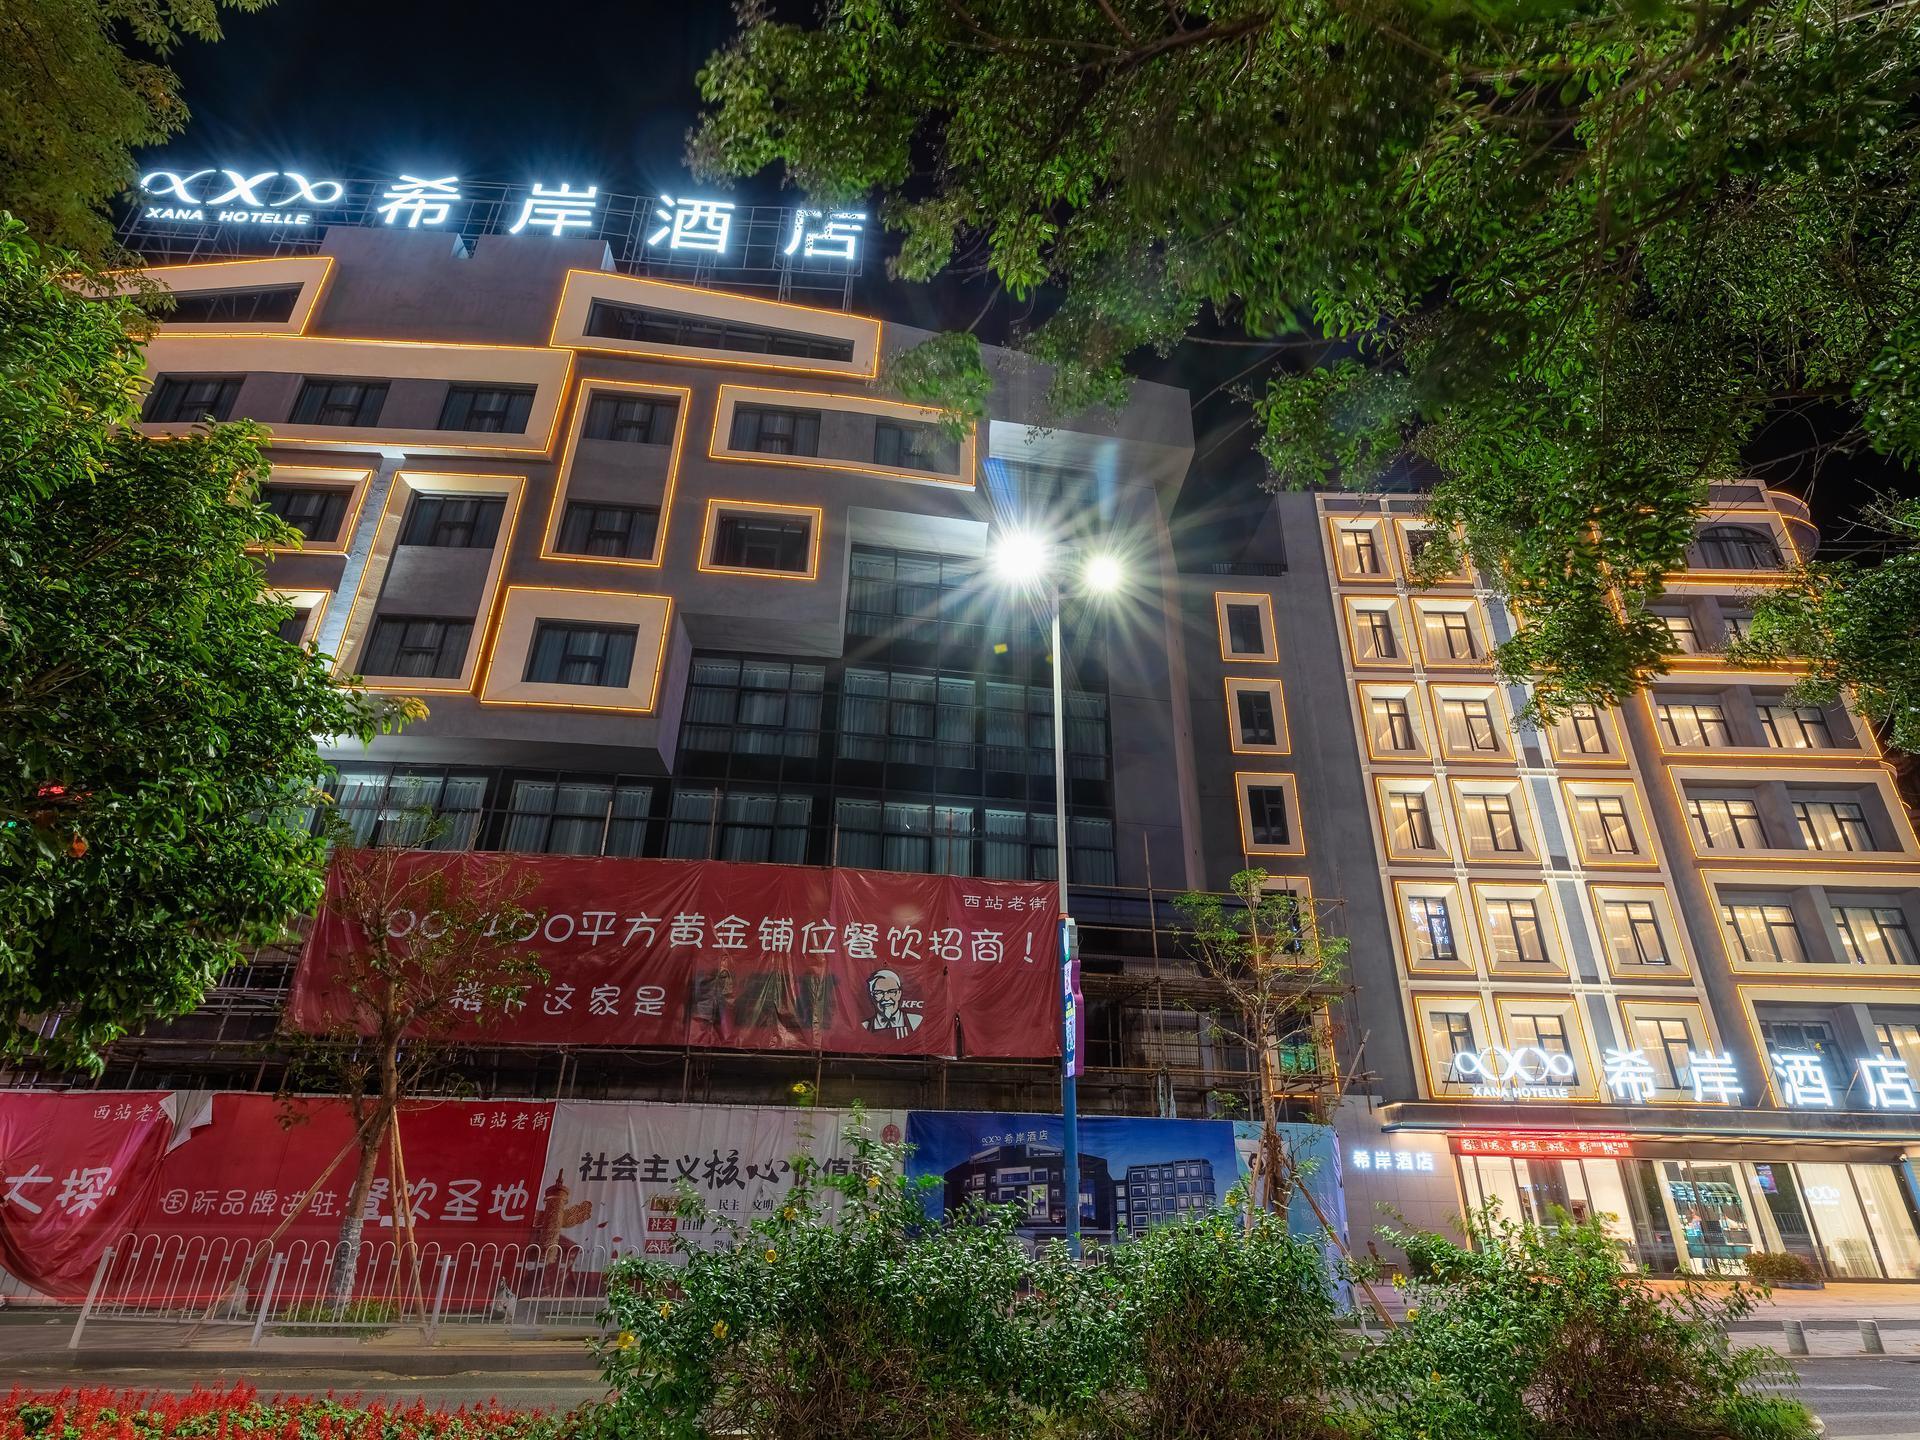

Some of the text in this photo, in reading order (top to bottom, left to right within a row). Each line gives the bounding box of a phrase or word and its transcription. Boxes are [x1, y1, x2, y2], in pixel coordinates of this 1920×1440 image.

[145, 207, 310, 226] XANA HOTELLE
[377, 174, 866, 260] 希岸酒店
[962, 894, 1047, 912] 西站老街
[901, 1000, 924, 1010] KFC
[1603, 1048, 1917, 1109] 希岸酒店
[1472, 1086, 1569, 1099] XANA HOTELLE
[470, 1111, 551, 1131] 西站老街
[1004, 1129, 1049, 1145] 希岸酒店
[1352, 1149, 1434, 1171] 希岸酒店
[719, 1200, 740, 1211] 民主
[752, 1199, 774, 1211] 文明
[650, 1218, 673, 1231] 社会
